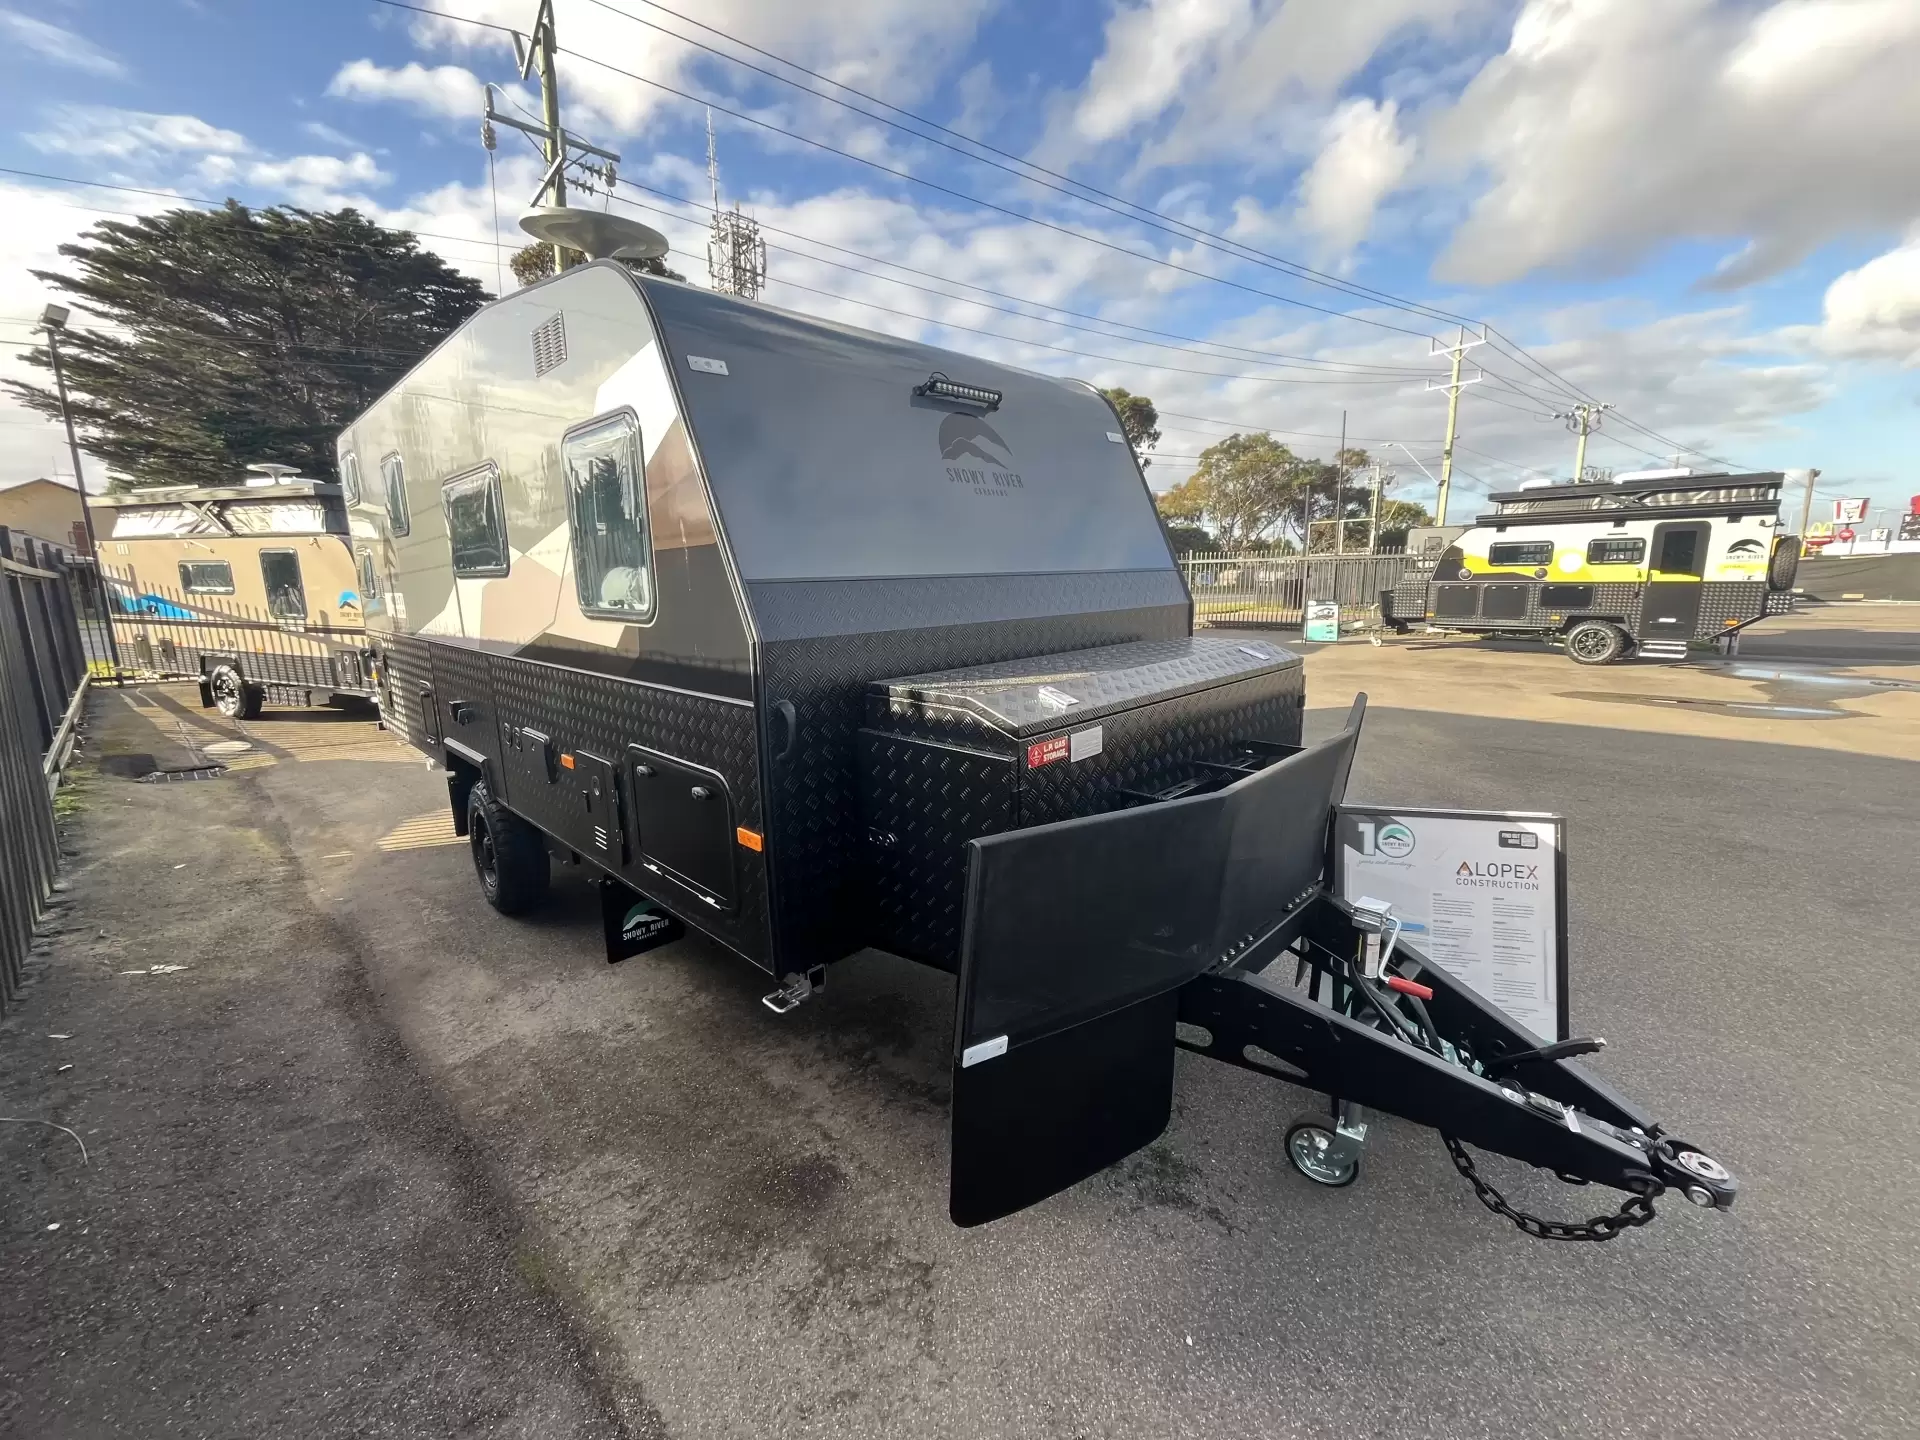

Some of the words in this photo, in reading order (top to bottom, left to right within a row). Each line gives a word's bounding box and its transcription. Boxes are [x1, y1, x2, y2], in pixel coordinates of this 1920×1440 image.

[946, 467, 986, 485] SNOWY
[992, 471, 1024, 489] RIVER
[974, 488, 1008, 496] CARAVANS
[1054, 740, 1066, 750] GAS
[1043, 748, 1066, 762] STORAGE
[1456, 861, 1538, 880] ALOPEX
[1456, 878, 1539, 890] CONSTRUCTION
[622, 927, 646, 940] SNOWY
[650, 919, 669, 930] RIVER
